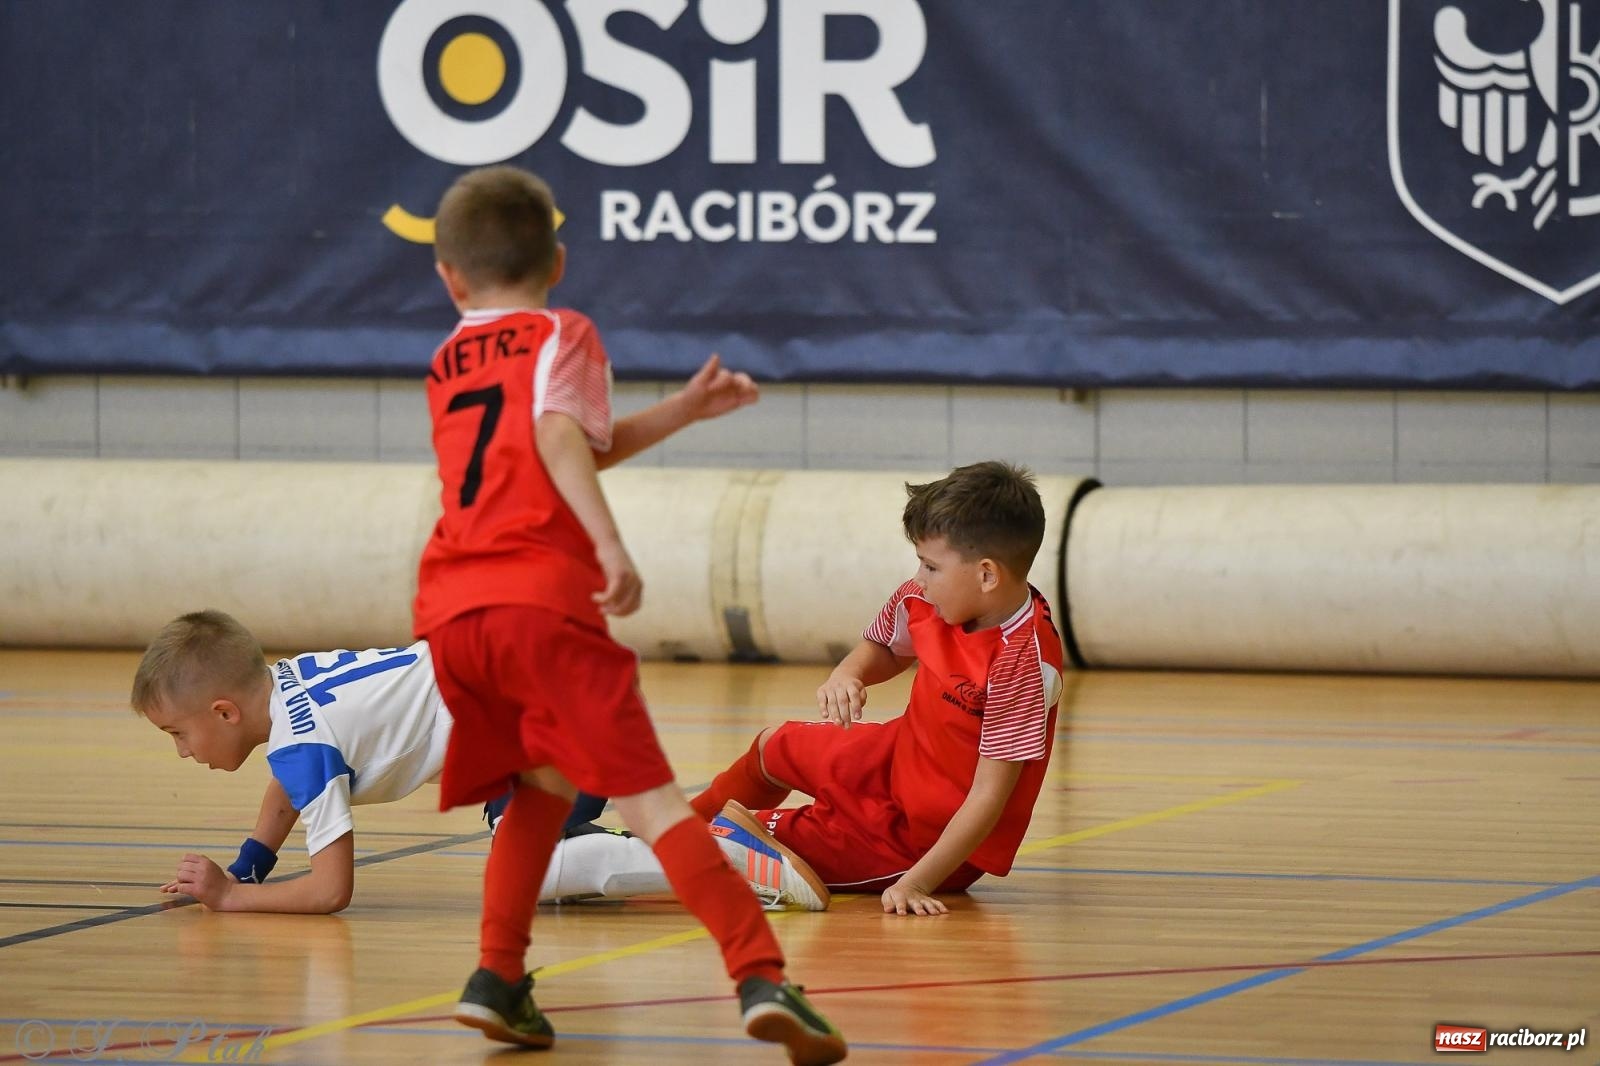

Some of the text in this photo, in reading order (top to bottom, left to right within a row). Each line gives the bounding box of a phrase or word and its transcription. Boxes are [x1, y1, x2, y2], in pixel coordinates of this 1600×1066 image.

[600, 174, 937, 243] RACIBÓRZ
[446, 382, 505, 510] 7
[284, 689, 317, 736] UNIA
